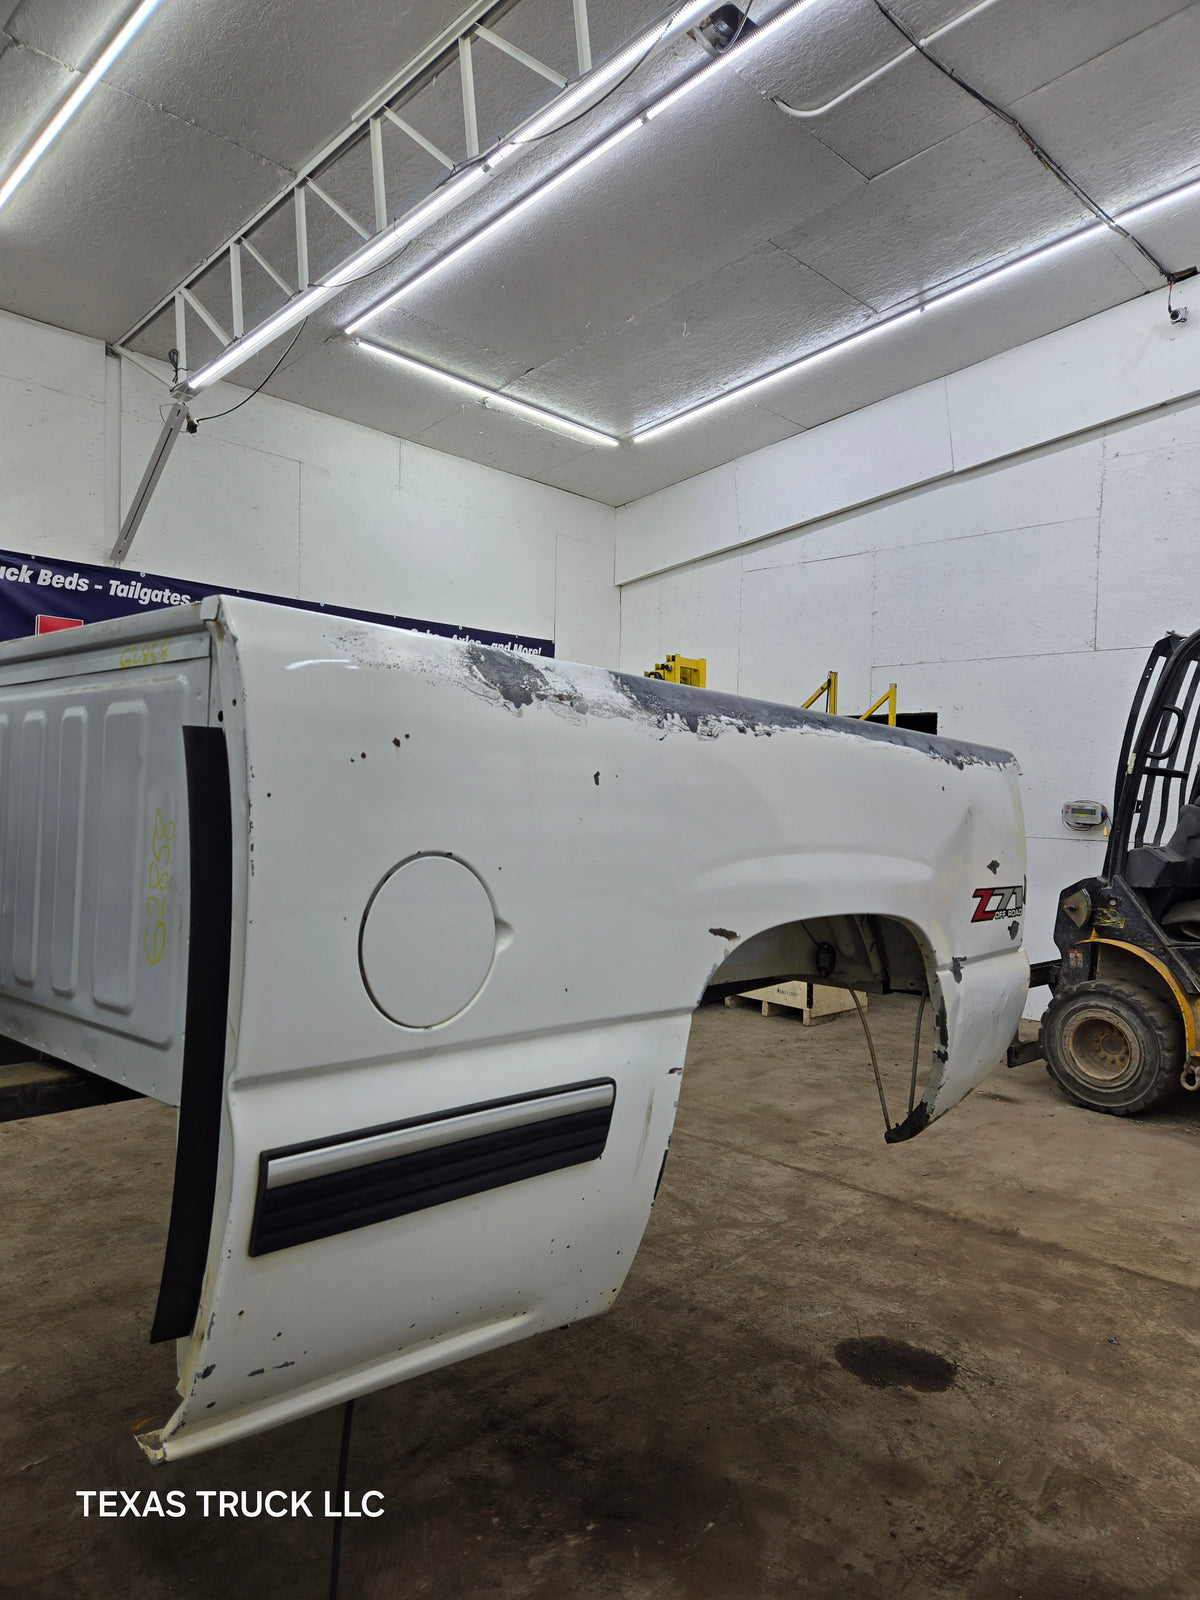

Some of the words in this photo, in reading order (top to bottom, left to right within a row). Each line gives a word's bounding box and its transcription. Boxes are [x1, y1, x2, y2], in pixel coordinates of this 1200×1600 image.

[37, 568, 89, 592] Beds
[109, 579, 191, 606] Tailgates
[971, 886, 1023, 923] Z71
[995, 910, 1006, 919] OFF
[1008, 908, 1022, 917] ROAD
